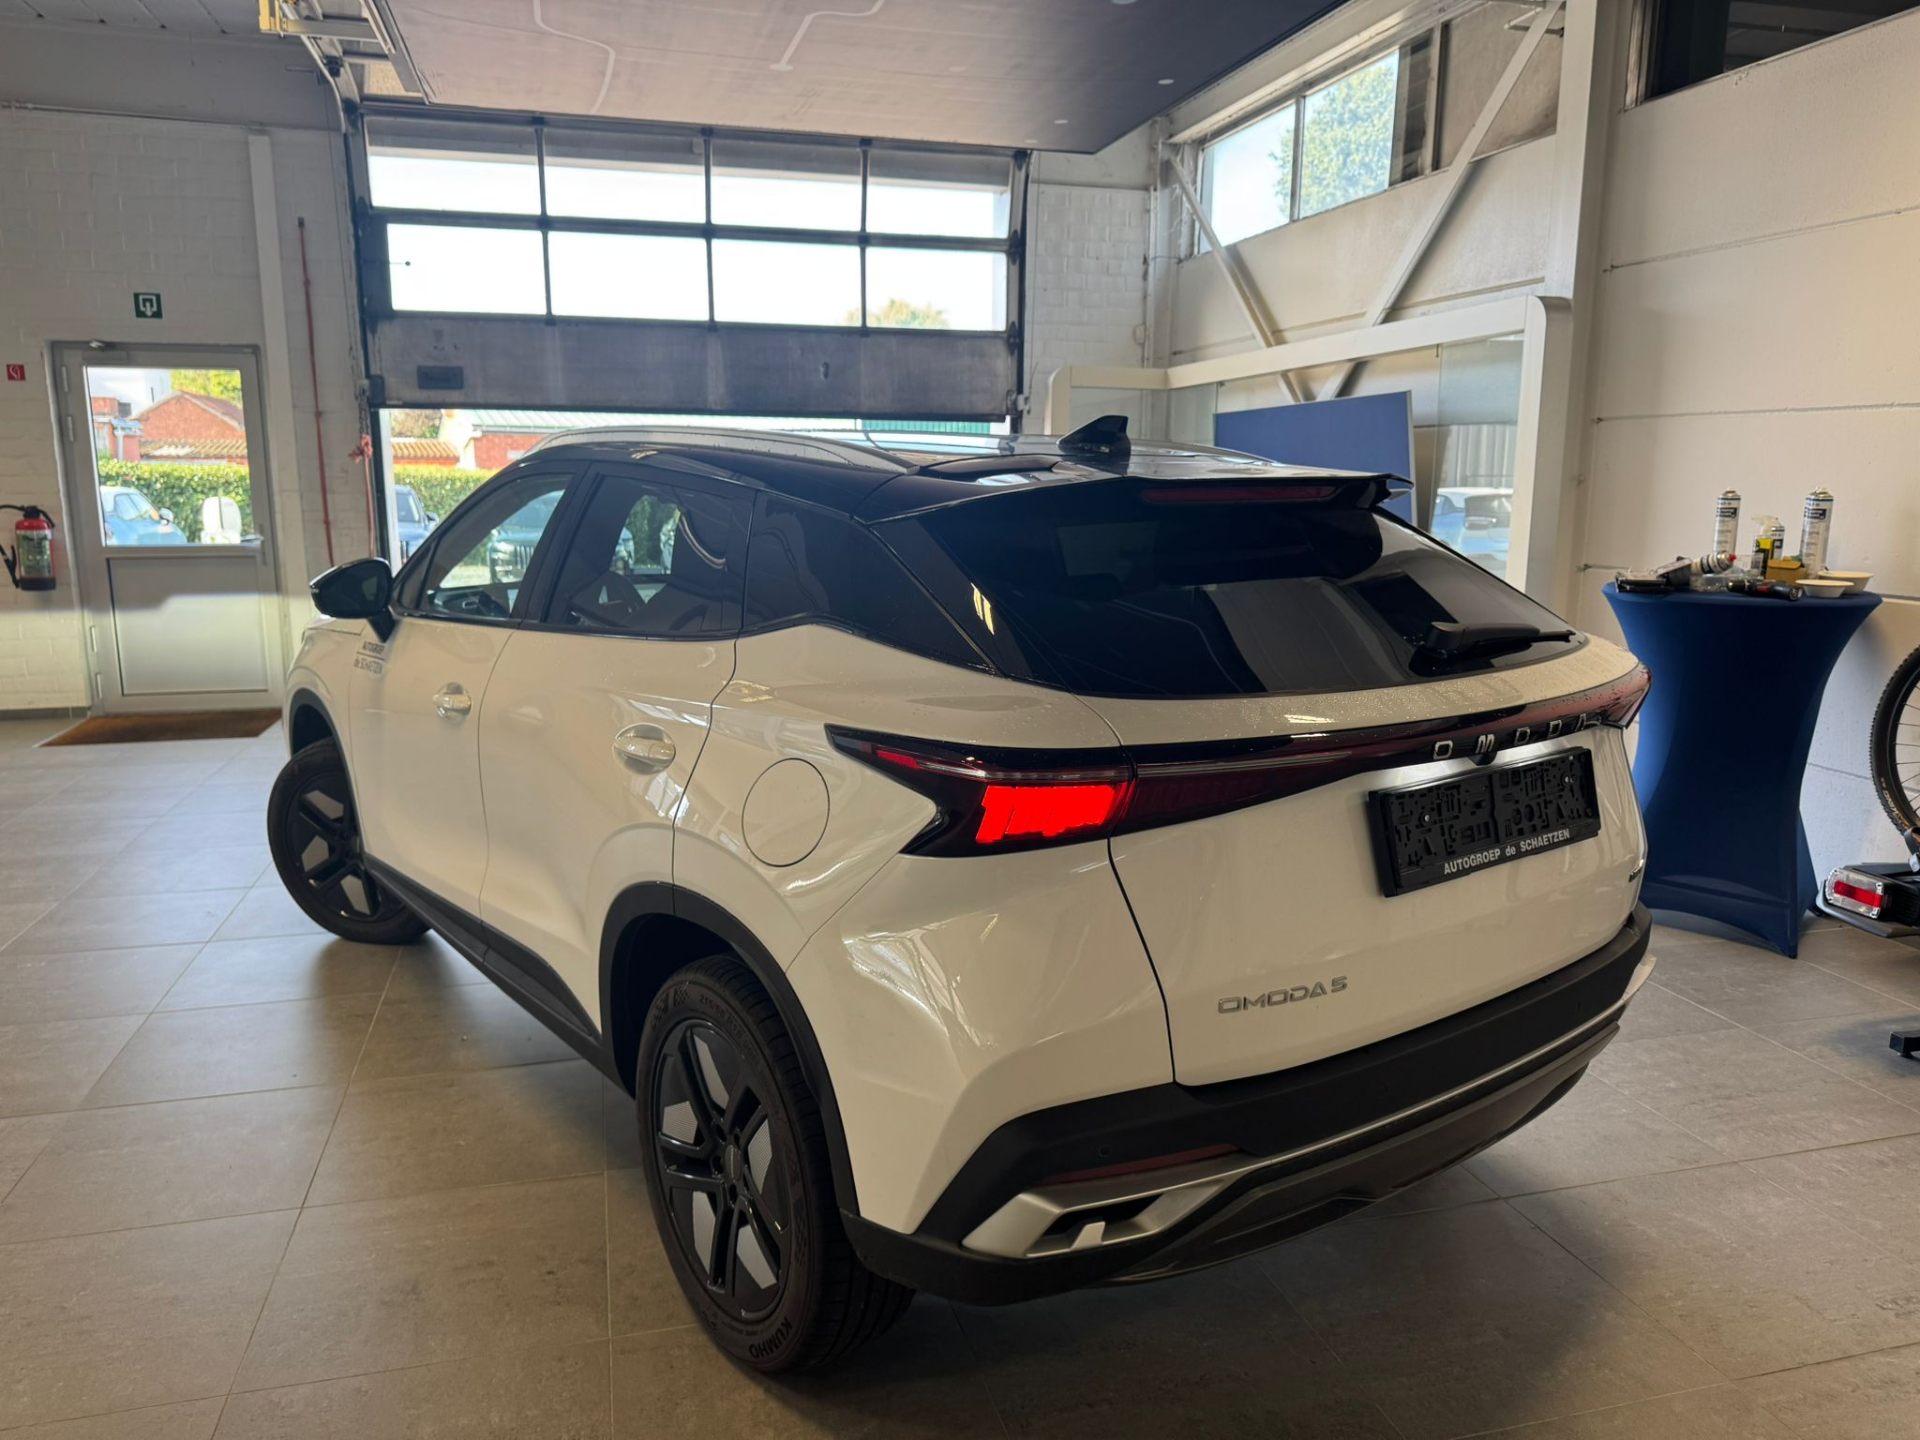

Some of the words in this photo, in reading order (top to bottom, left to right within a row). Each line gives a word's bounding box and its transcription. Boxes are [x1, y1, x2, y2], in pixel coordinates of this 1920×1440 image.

[1444, 848, 1501, 875] AUTOGROEP
[1505, 845, 1516, 856] de
[1520, 828, 1571, 853] SCHAETZEN
[1217, 981, 1327, 1014] OMODA
[748, 1316, 793, 1359] KUMHO
